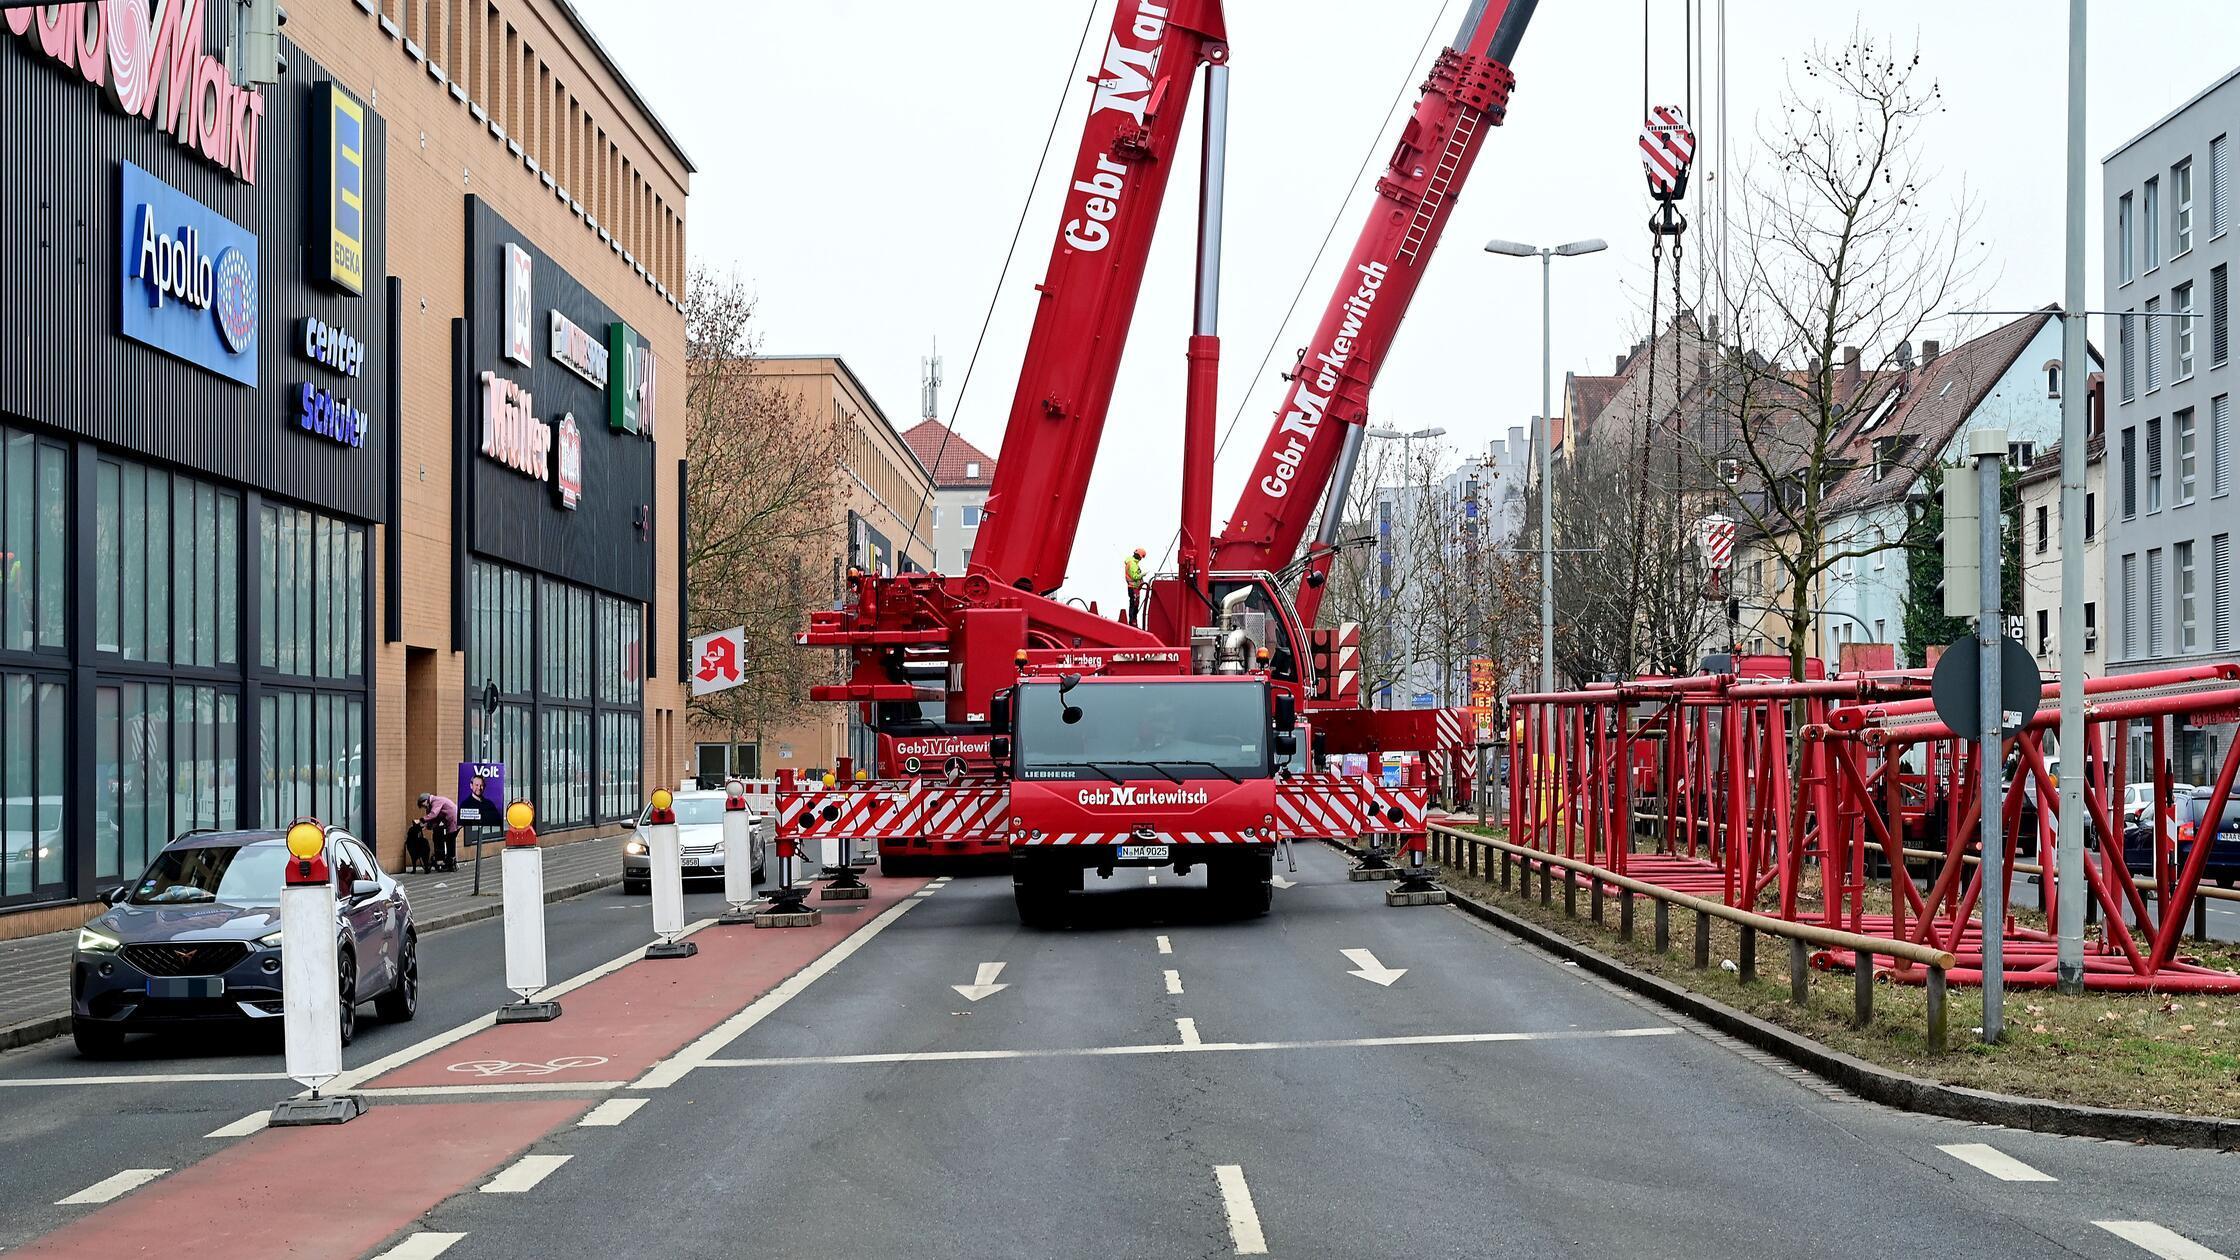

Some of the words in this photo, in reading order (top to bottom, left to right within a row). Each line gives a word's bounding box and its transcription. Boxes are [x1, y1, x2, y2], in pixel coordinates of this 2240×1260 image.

[1064, 152, 1128, 252] Gebr
[138, 203, 213, 311] Apollo
[334, 241, 361, 277] EDEKA
[305, 316, 365, 378] center
[1279, 260, 1389, 443] Markewitsch
[1260, 436, 1307, 499] Gebr
[2010, 615, 2024, 645] NO
[897, 742, 926, 755] Gebr
[922, 738, 990, 757] Markewi
[473, 765, 500, 778] Volt
[1024, 770, 1076, 778] LIEBHERR
[1078, 788, 1110, 805] Gebr
[1110, 786, 1208, 806] Markewitsch
[1123, 847, 1129, 856] N
[1133, 847, 1145, 856] MA
[1146, 847, 1167, 856] 9025
